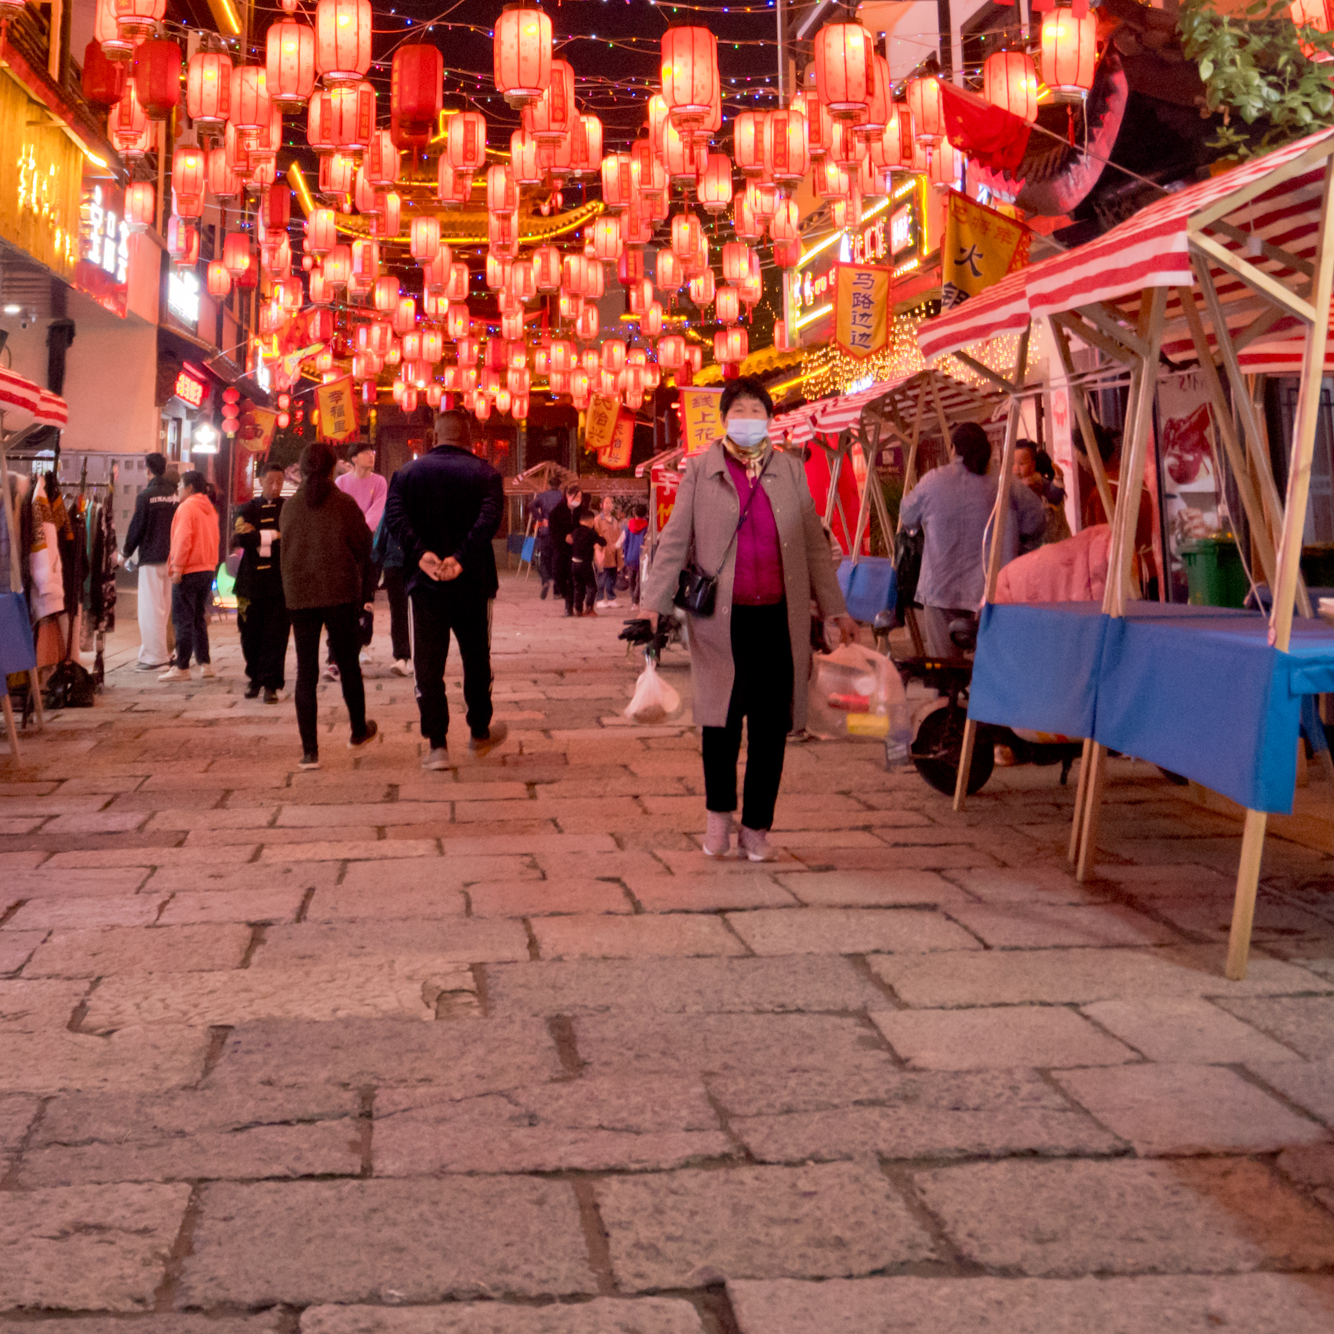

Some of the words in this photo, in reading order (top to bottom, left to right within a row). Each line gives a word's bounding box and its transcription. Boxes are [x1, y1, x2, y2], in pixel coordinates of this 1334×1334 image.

[850, 272, 875, 350] 马路边边
[328, 390, 349, 435] 幸福里
